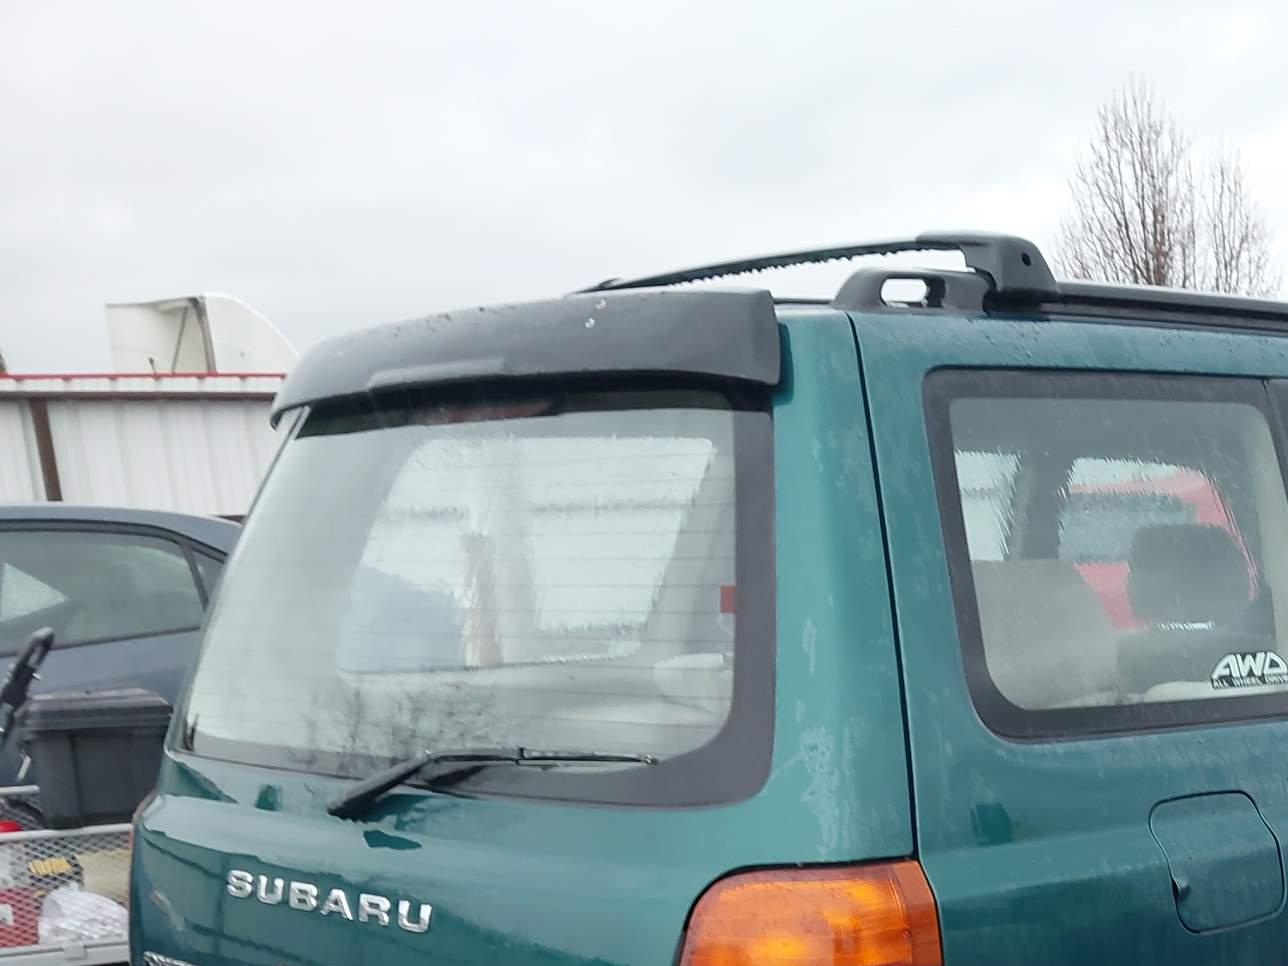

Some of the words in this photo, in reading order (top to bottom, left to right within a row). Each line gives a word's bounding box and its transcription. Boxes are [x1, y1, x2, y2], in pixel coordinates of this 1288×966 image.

[1211, 651, 1288, 679] AWD
[1212, 678, 1231, 688] ALL
[1231, 675, 1262, 687] WHEEL
[1264, 673, 1288, 684] DRIVE
[226, 869, 433, 934] SUBARU
